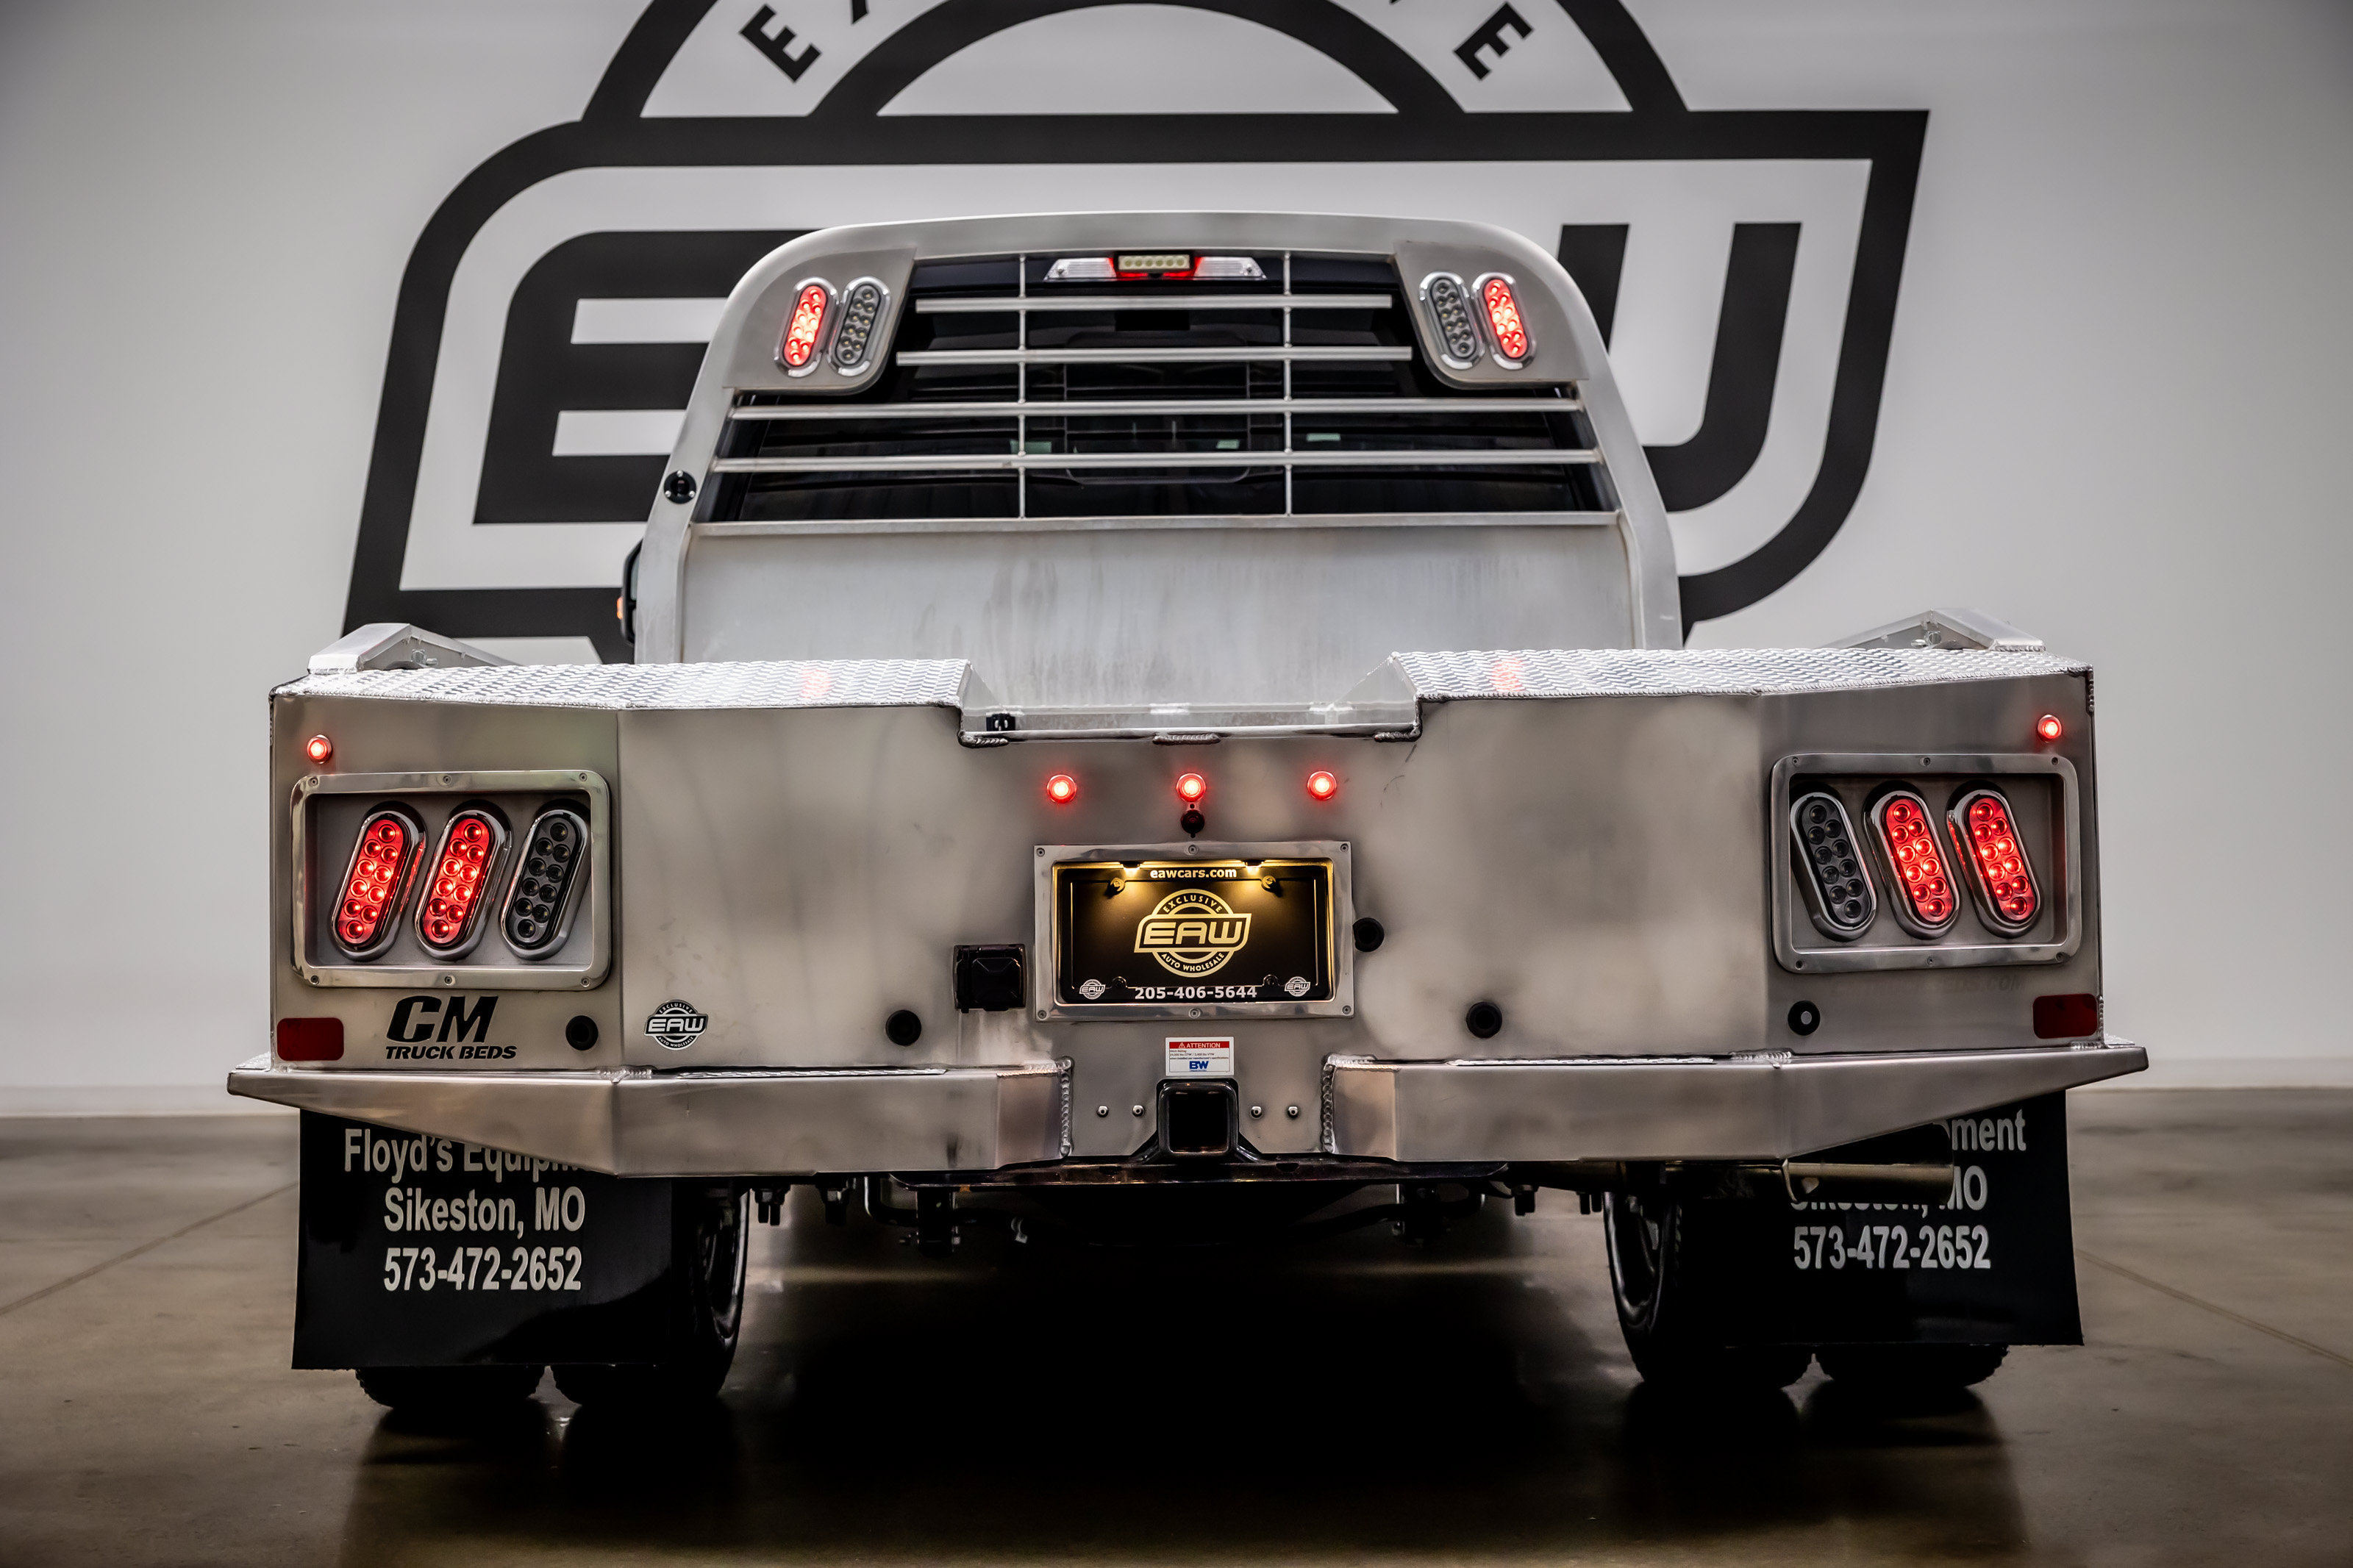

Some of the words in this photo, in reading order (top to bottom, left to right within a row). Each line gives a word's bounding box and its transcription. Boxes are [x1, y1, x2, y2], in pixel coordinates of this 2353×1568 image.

[1150, 869, 1237, 878] eawcars.com
[1163, 895, 1223, 913] EXCLUSIVE
[1143, 921, 1243, 945] EAW
[1161, 953, 1181, 968] AUTO
[1183, 952, 1224, 972] WHOLESALE
[1135, 986, 1257, 1000] 205-406-5644
[659, 1003, 693, 1014] EXCLUSIVE
[386, 995, 499, 1043] CM
[648, 1018, 704, 1032] EAW
[658, 1037, 669, 1046] AUTO
[385, 1045, 456, 1060] TRUCK
[459, 1045, 518, 1060] BEDS
[344, 1128, 452, 1184] Floyd's
[384, 1187, 524, 1239] Sikeston,
[535, 1187, 585, 1231] MO
[1793, 1225, 1991, 1270] 573-472-2652
[384, 1247, 583, 1292] 573-472-2652
